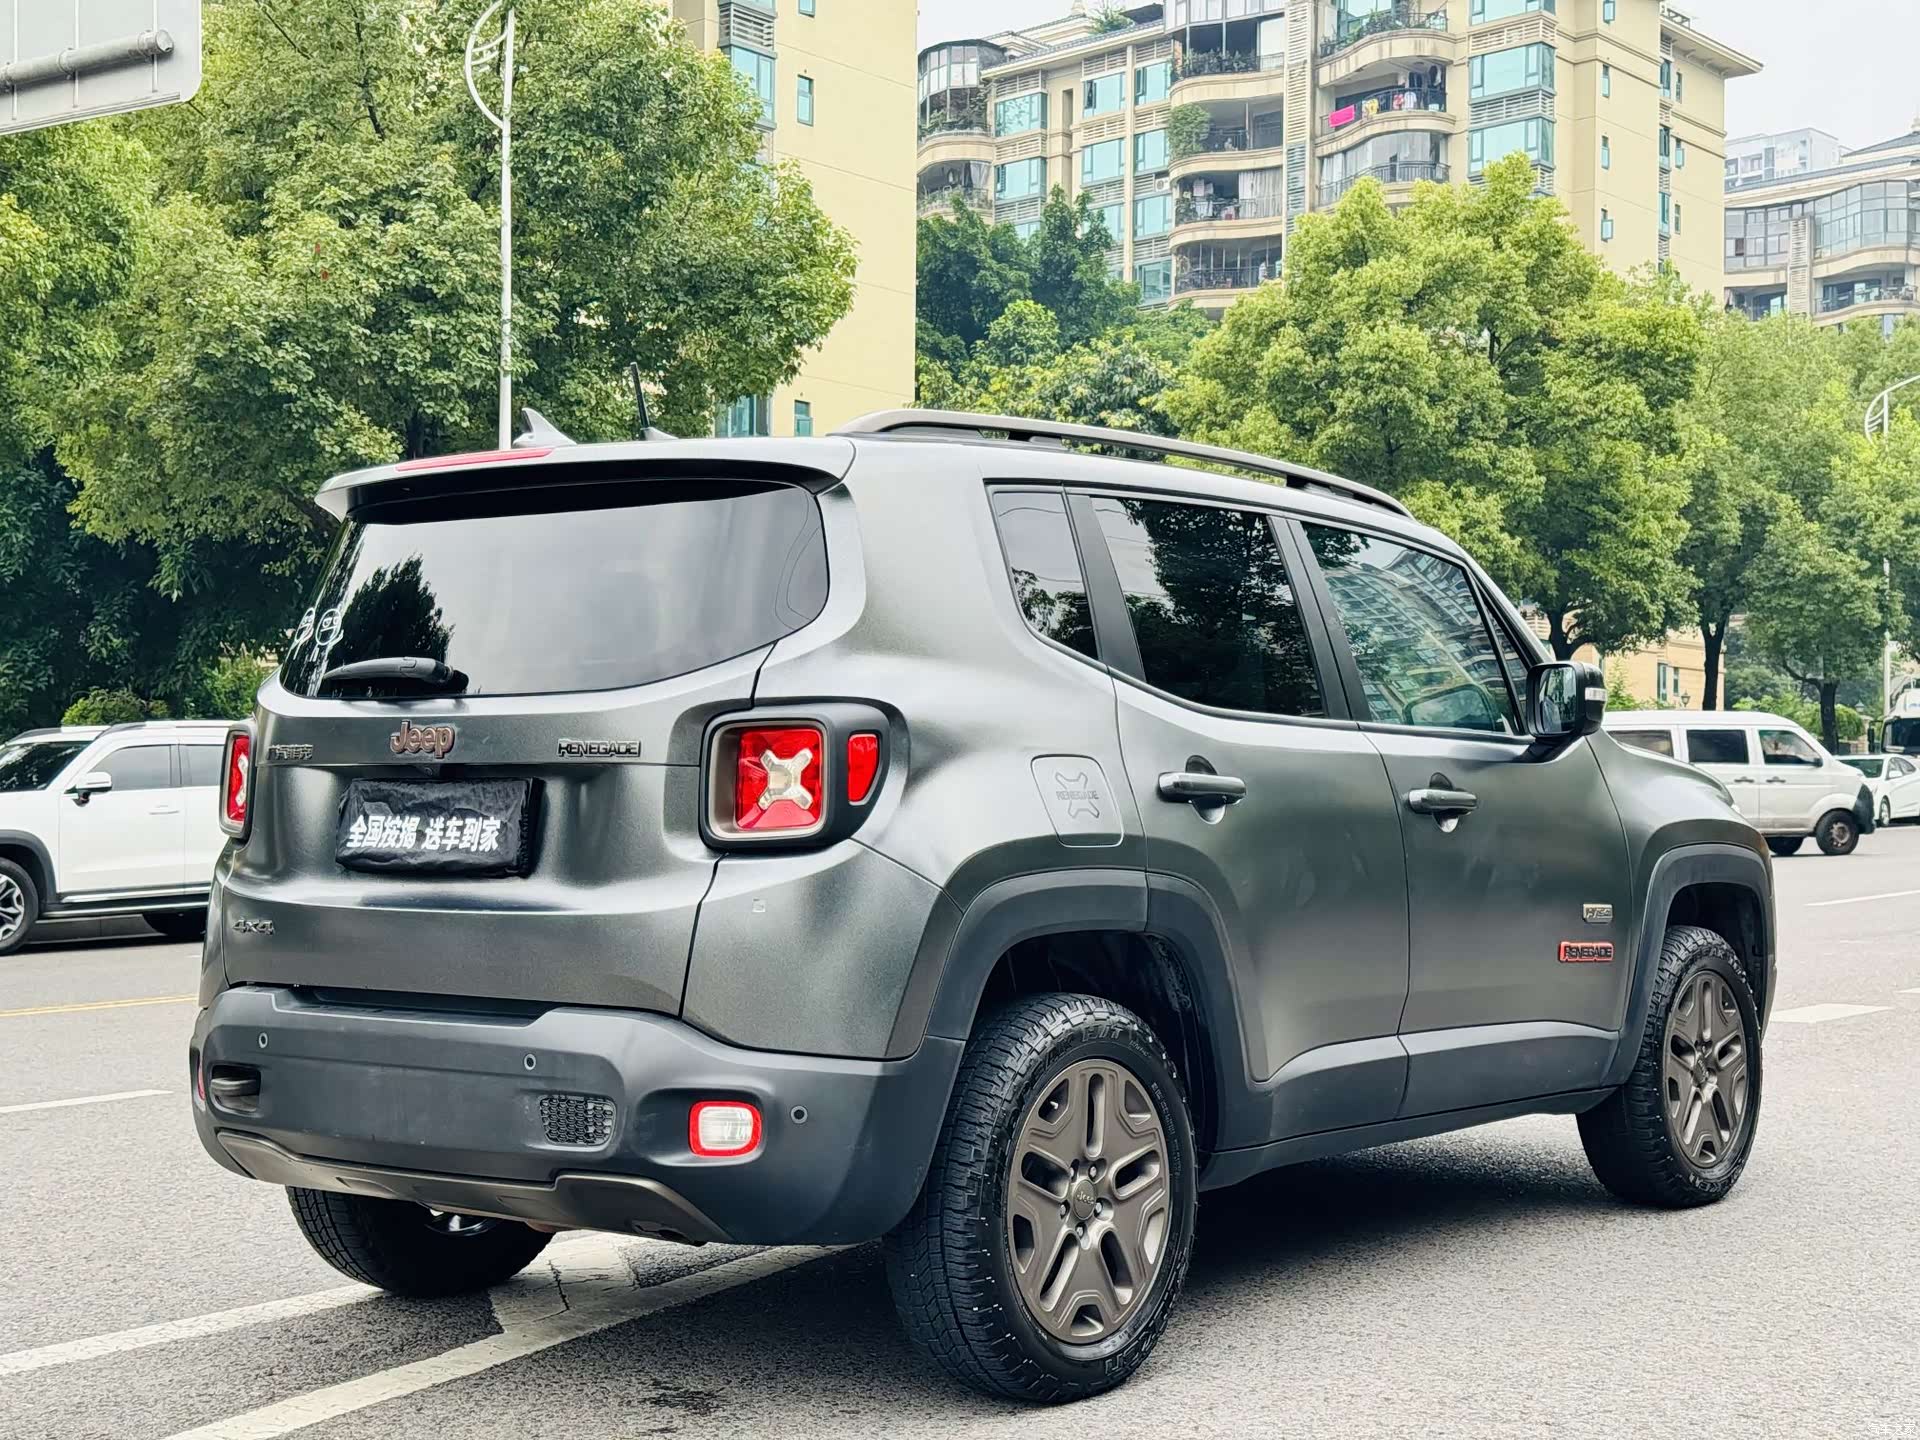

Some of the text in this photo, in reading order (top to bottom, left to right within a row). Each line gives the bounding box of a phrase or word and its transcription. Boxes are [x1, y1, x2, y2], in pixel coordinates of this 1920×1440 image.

[389, 719, 455, 759] Jeep
[557, 738, 641, 757] RENEGADE
[346, 814, 500, 852] 全国按揭 送车到家
[1558, 941, 1613, 962] RENEGADE
